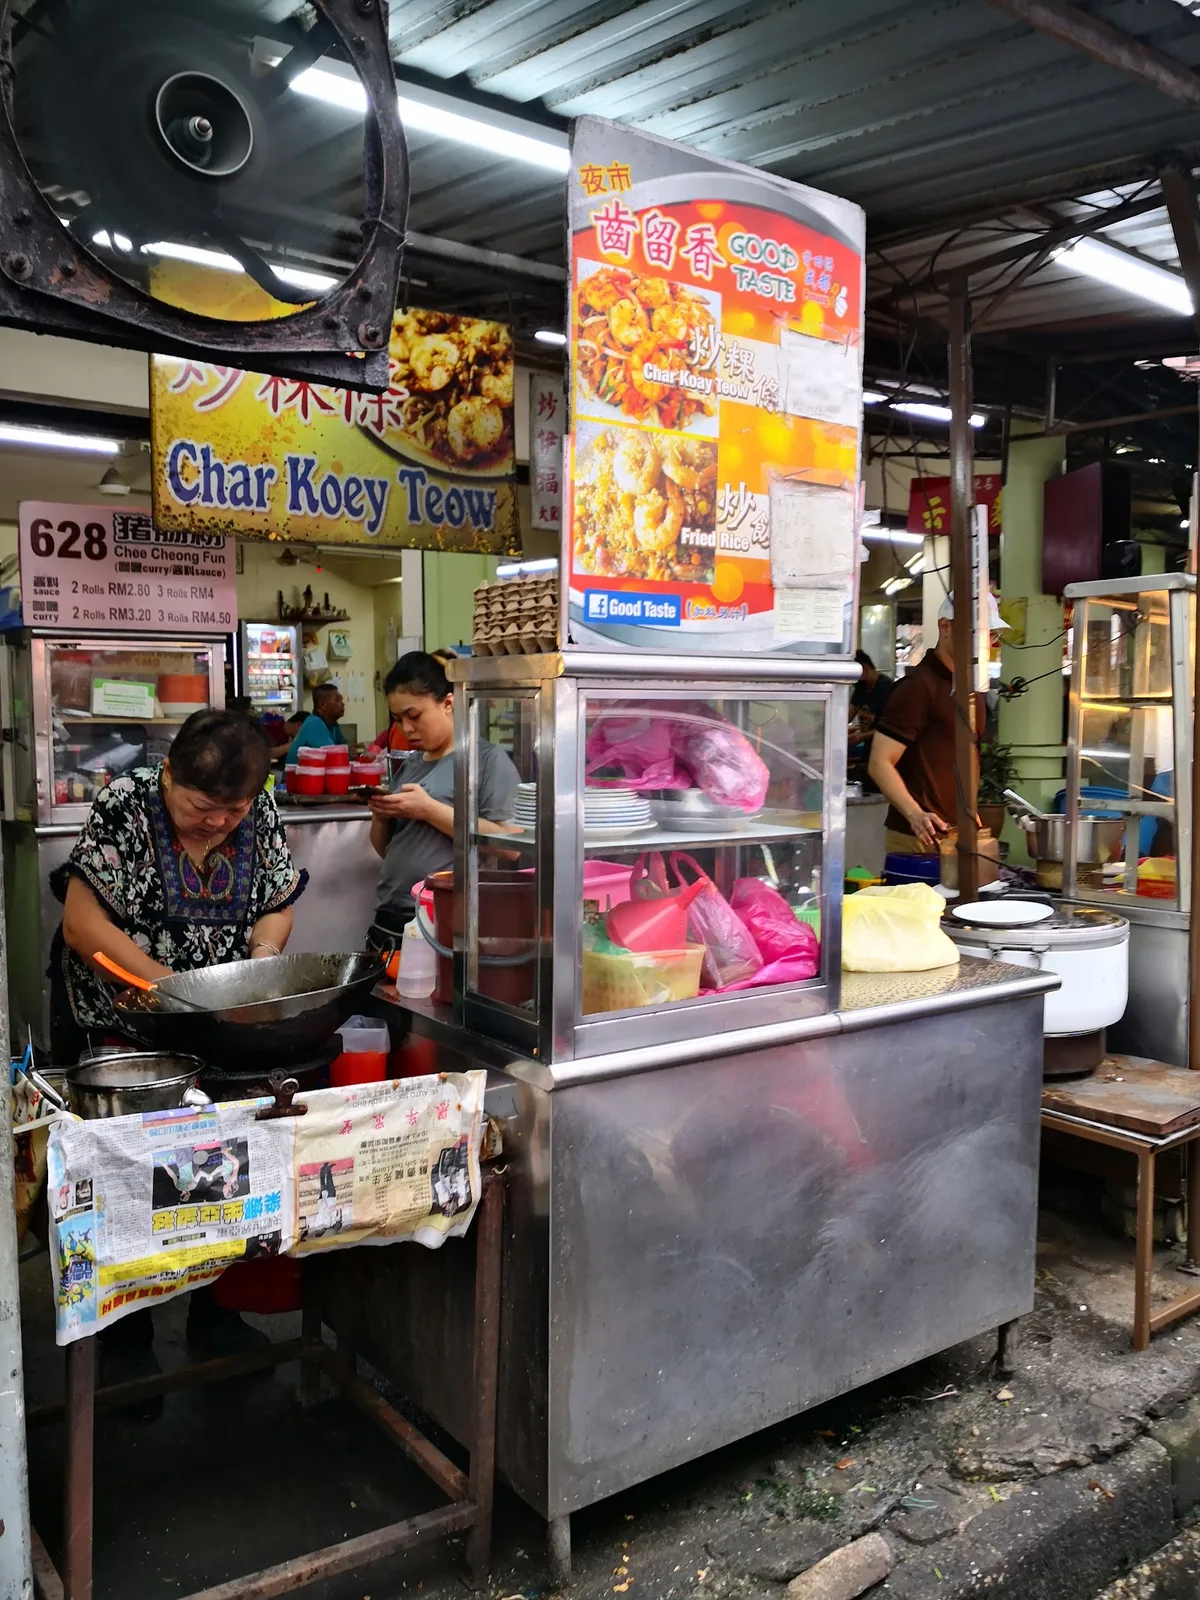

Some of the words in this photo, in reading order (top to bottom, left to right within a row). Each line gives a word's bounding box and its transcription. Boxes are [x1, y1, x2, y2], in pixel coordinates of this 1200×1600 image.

[579, 161, 632, 195] 夜市
[593, 199, 727, 279] 齒留香
[730, 234, 797, 270] GOOD
[732, 266, 794, 300] TASTE
[643, 361, 677, 386] Char
[679, 369, 712, 395] Koay
[716, 376, 749, 400] Teow
[168, 441, 276, 511] Char
[286, 455, 389, 534] Koey
[399, 469, 498, 530] Teow
[30, 518, 108, 561] 628
[681, 527, 716, 548] Fried
[720, 530, 750, 552] Rice
[114, 545, 147, 559] Chee
[151, 547, 199, 565] Cheong
[203, 551, 226, 564] Fun
[33, 588, 60, 596] sauce
[72, 580, 79, 594] 2
[82, 584, 105, 595] Rolls
[108, 582, 150, 597] RM2.80
[157, 584, 163, 598] 3
[167, 587, 188, 599] Rolls
[190, 586, 214, 600] RM4
[33, 613, 59, 623] curry
[73, 606, 79, 619] 2
[83, 609, 105, 621] Rolls
[109, 607, 151, 622] RM3.20
[158, 609, 164, 622] 3
[168, 612, 189, 623] Rolls
[192, 611, 231, 625] RM4.50
[610, 600, 641, 617] Good
[643, 601, 677, 619] Taste
[335, 634, 347, 645] 21
[384, 1093, 409, 1102] SUPPLY
[409, 1089, 428, 1098] AUTO
